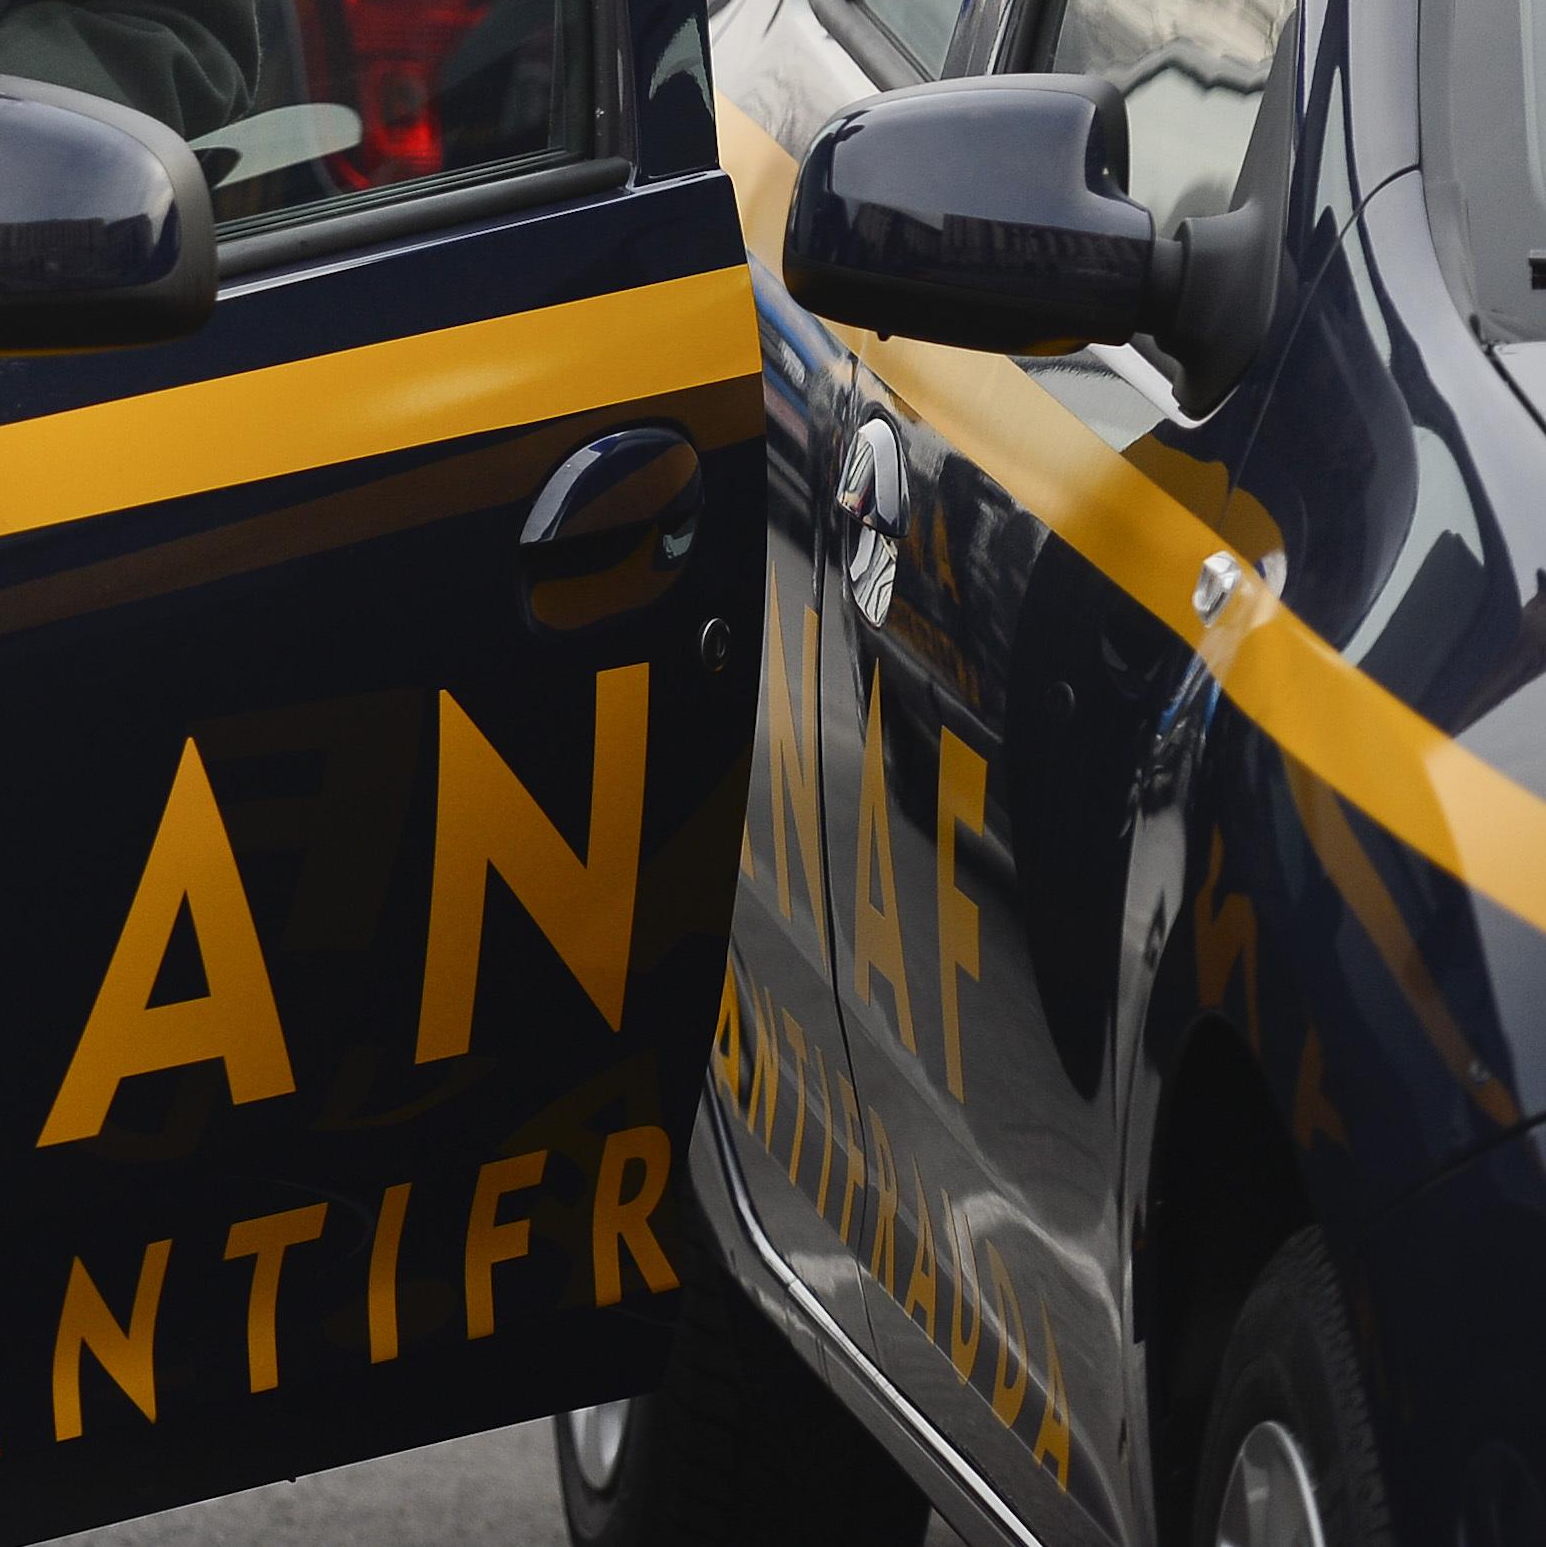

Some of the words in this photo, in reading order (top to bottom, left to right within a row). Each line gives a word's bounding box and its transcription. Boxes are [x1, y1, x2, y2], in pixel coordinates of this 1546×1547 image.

[35, 661, 650, 1147] AN
[741, 559, 988, 1105] NAF
[713, 956, 1070, 1494] ANTIFRAUDA
